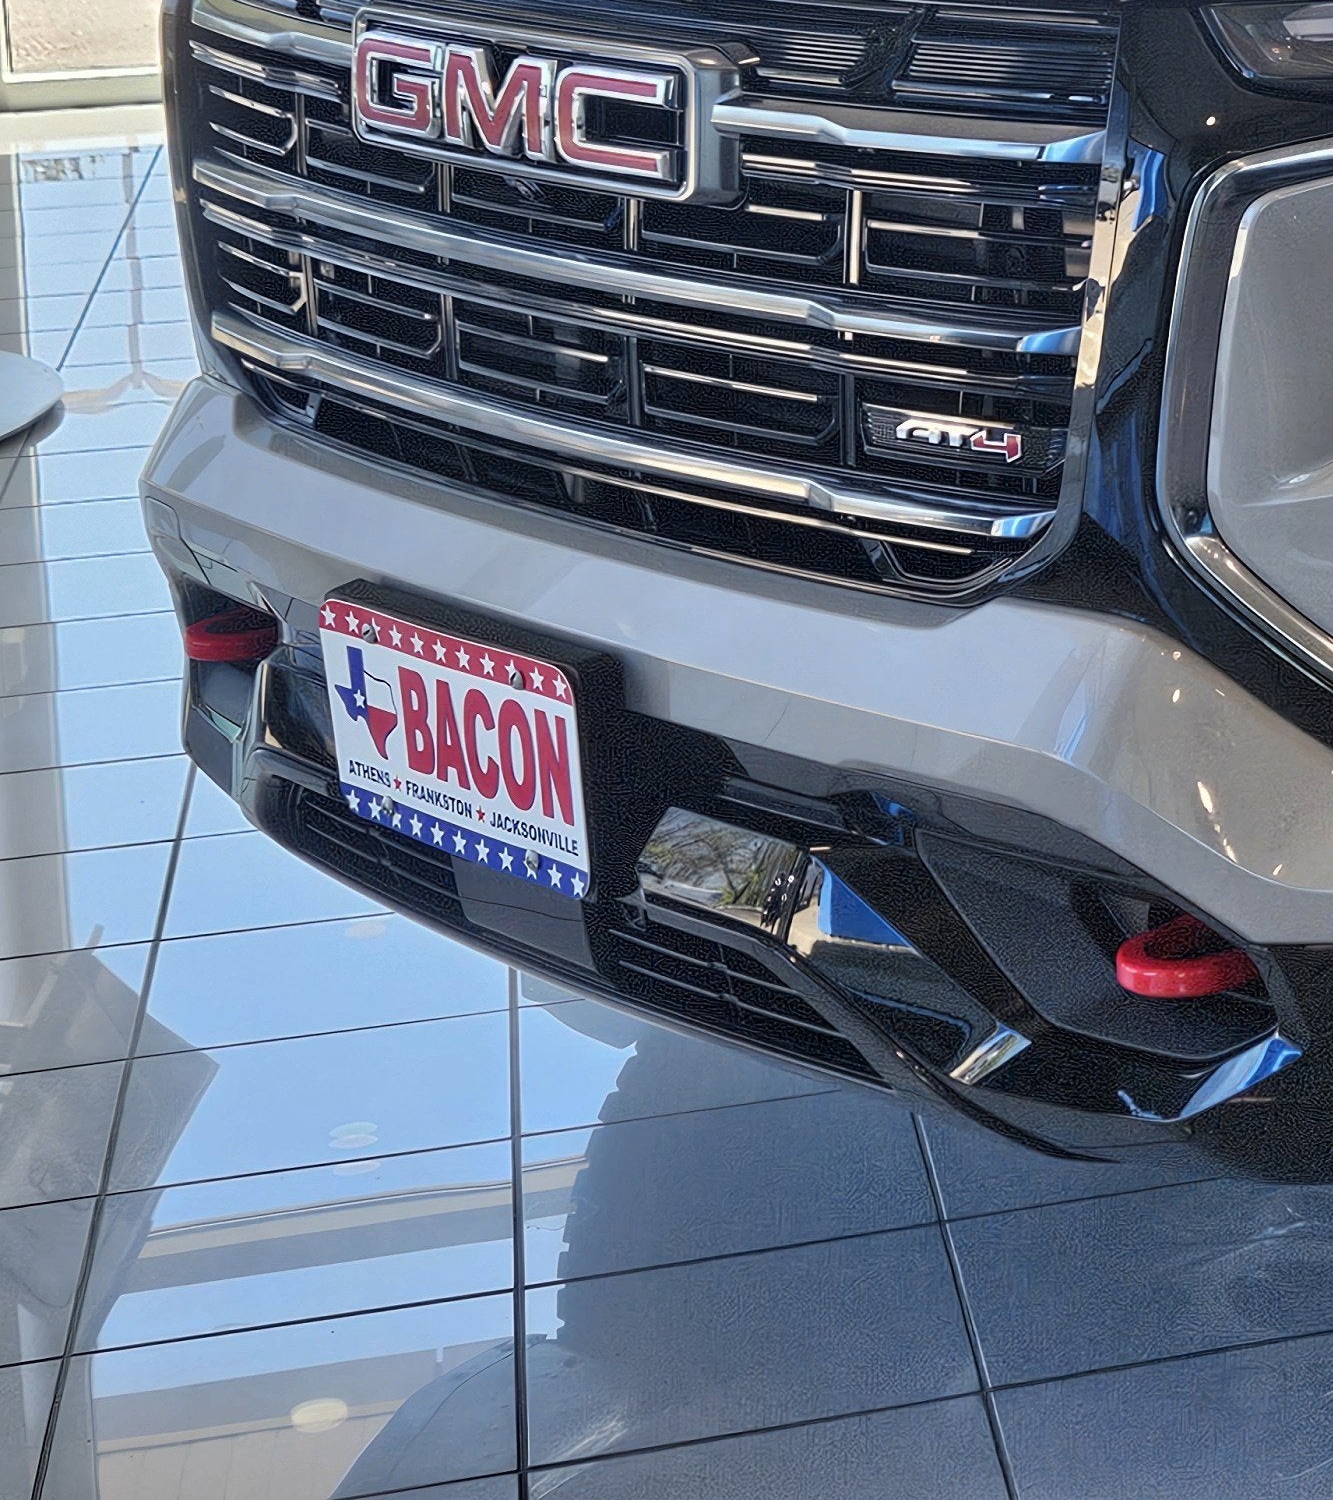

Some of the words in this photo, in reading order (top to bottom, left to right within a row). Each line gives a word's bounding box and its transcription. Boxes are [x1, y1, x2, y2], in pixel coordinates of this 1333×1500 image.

[353, 28, 678, 183] GMC
[895, 417, 1022, 464] AT4
[348, 759, 392, 789] ATHENS
[405, 779, 473, 820] FRANKSTON
[489, 810, 580, 857] JACKSONVILLE
[397, 665, 576, 828] BACON
